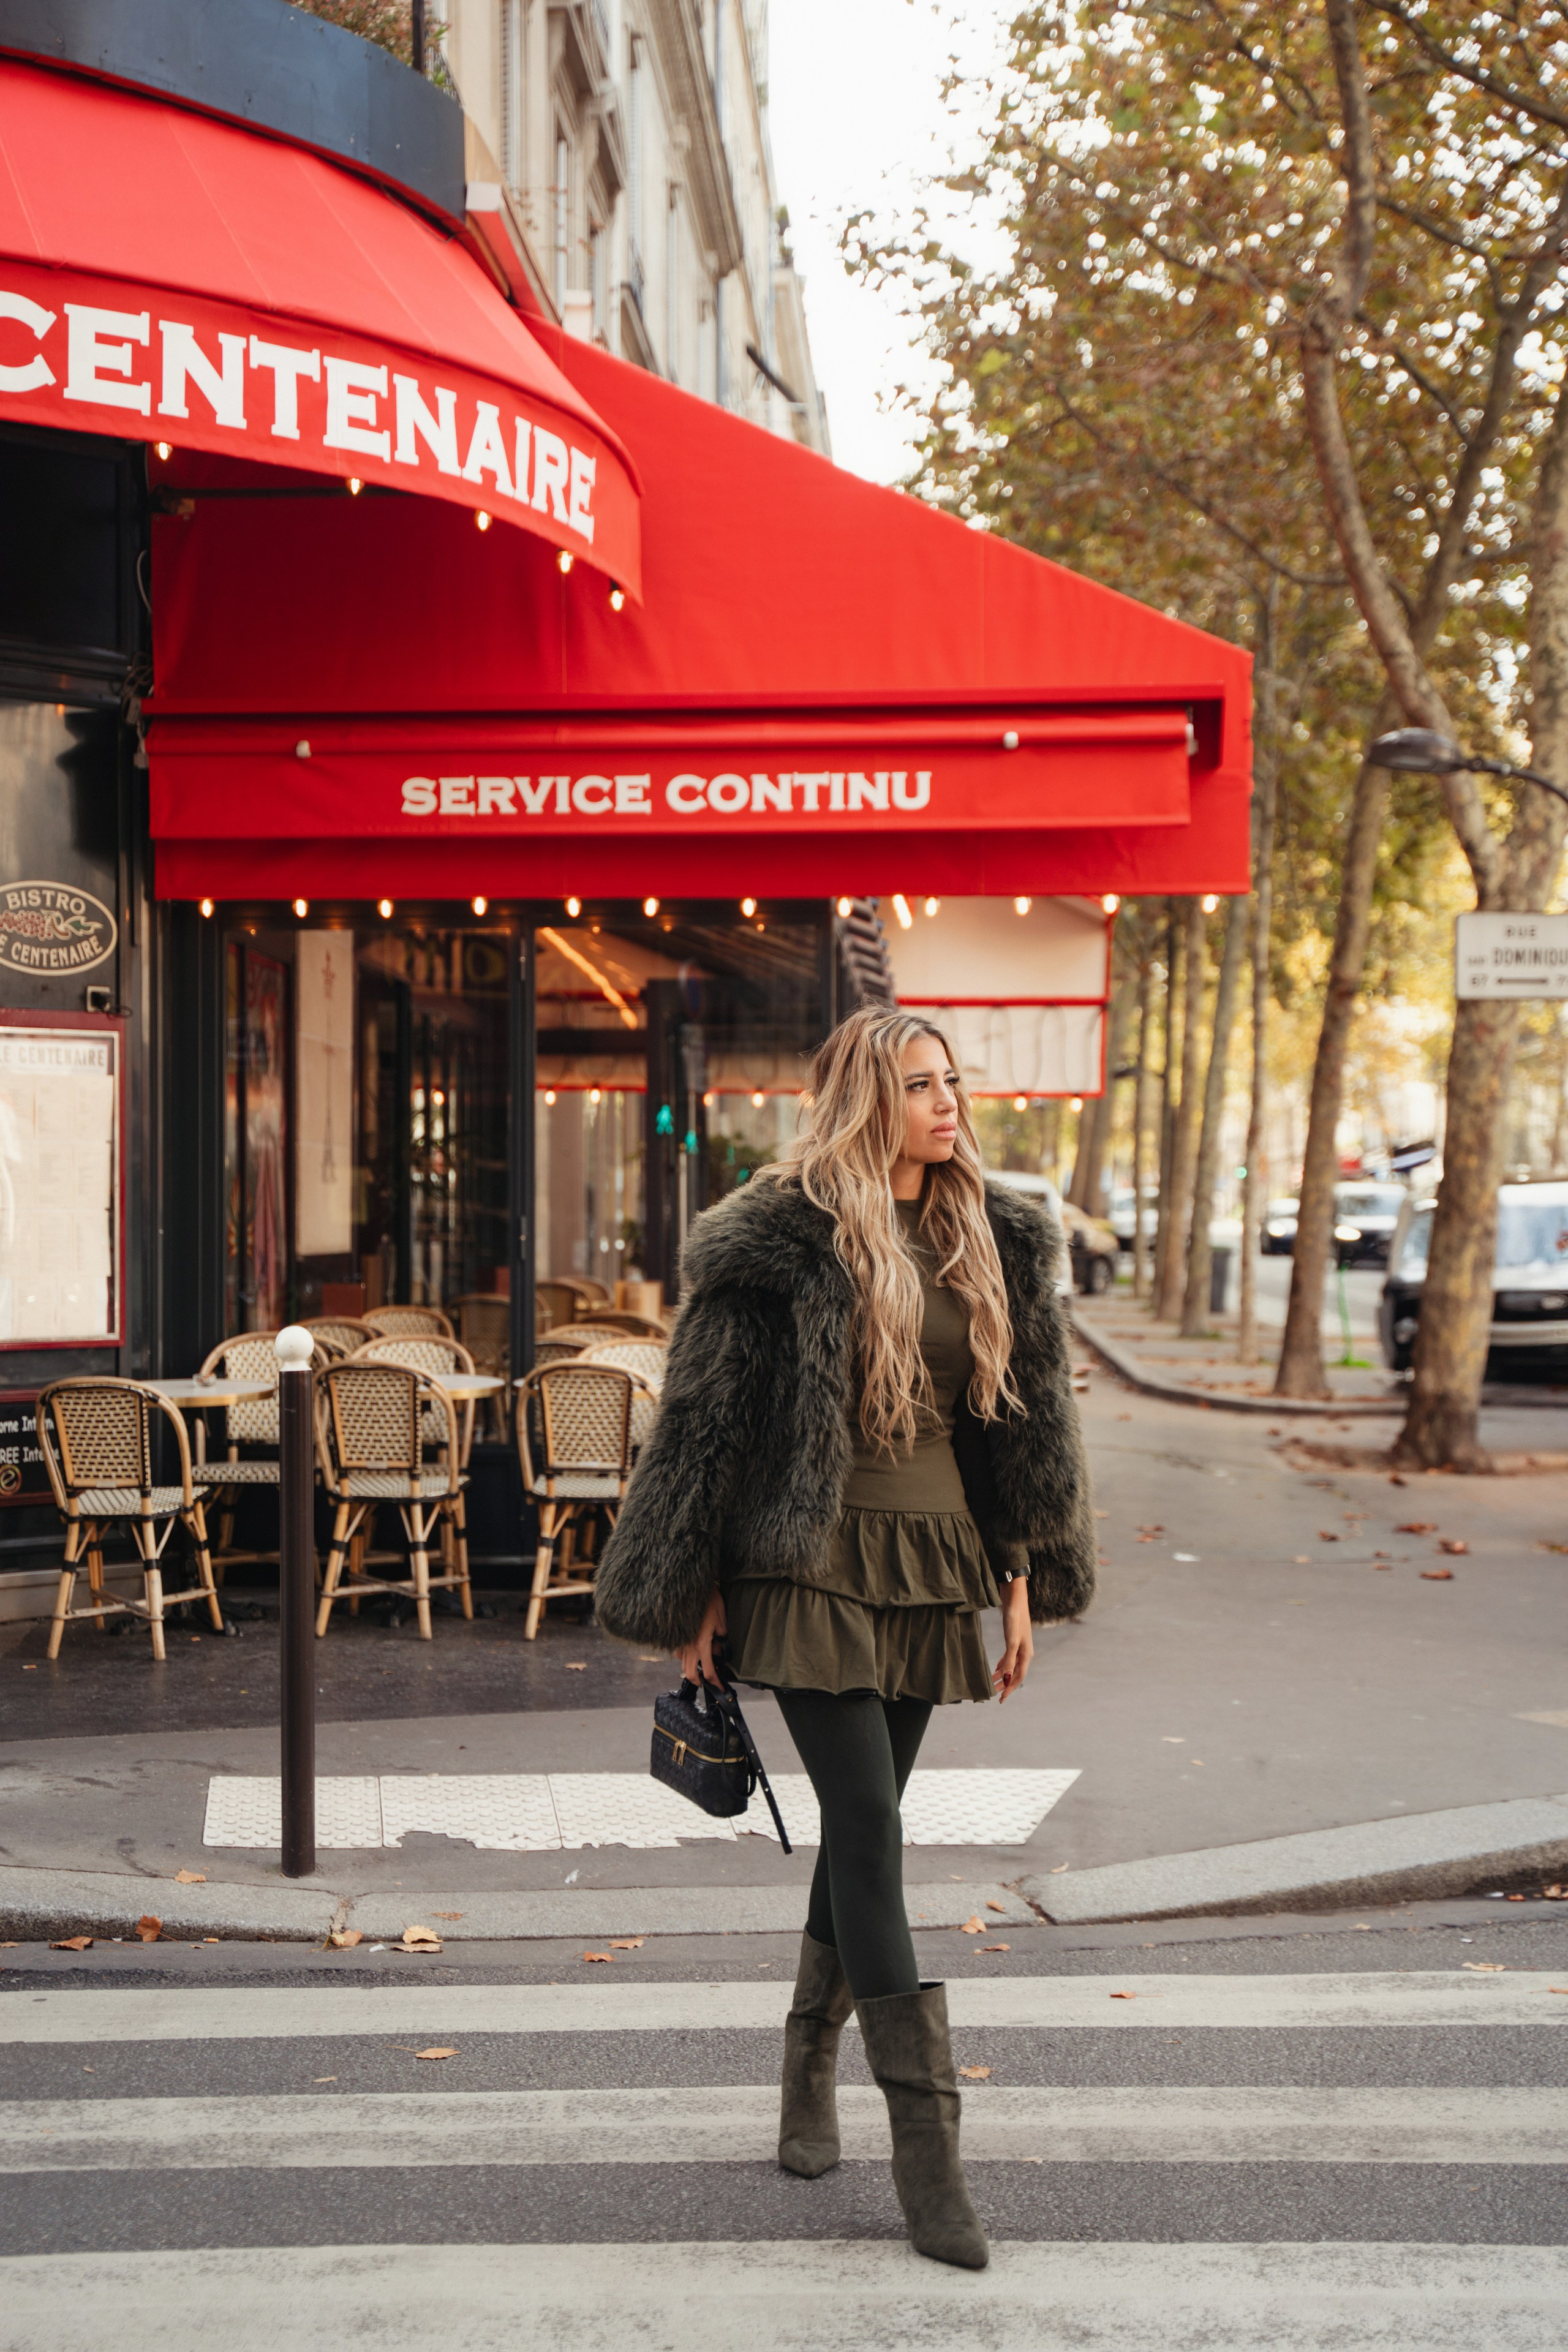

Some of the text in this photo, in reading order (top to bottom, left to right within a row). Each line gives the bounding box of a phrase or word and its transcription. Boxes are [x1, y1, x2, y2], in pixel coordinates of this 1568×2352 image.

[0, 291, 597, 545] CENTENAIRE
[401, 771, 932, 816] SERVICE CONTINU
[6, 889, 86, 915] BISTRO
[1505, 925, 1538, 940] RUE
[11, 935, 104, 968] CENTENAIRE
[18, 1046, 105, 1066] CENTENAIRE
